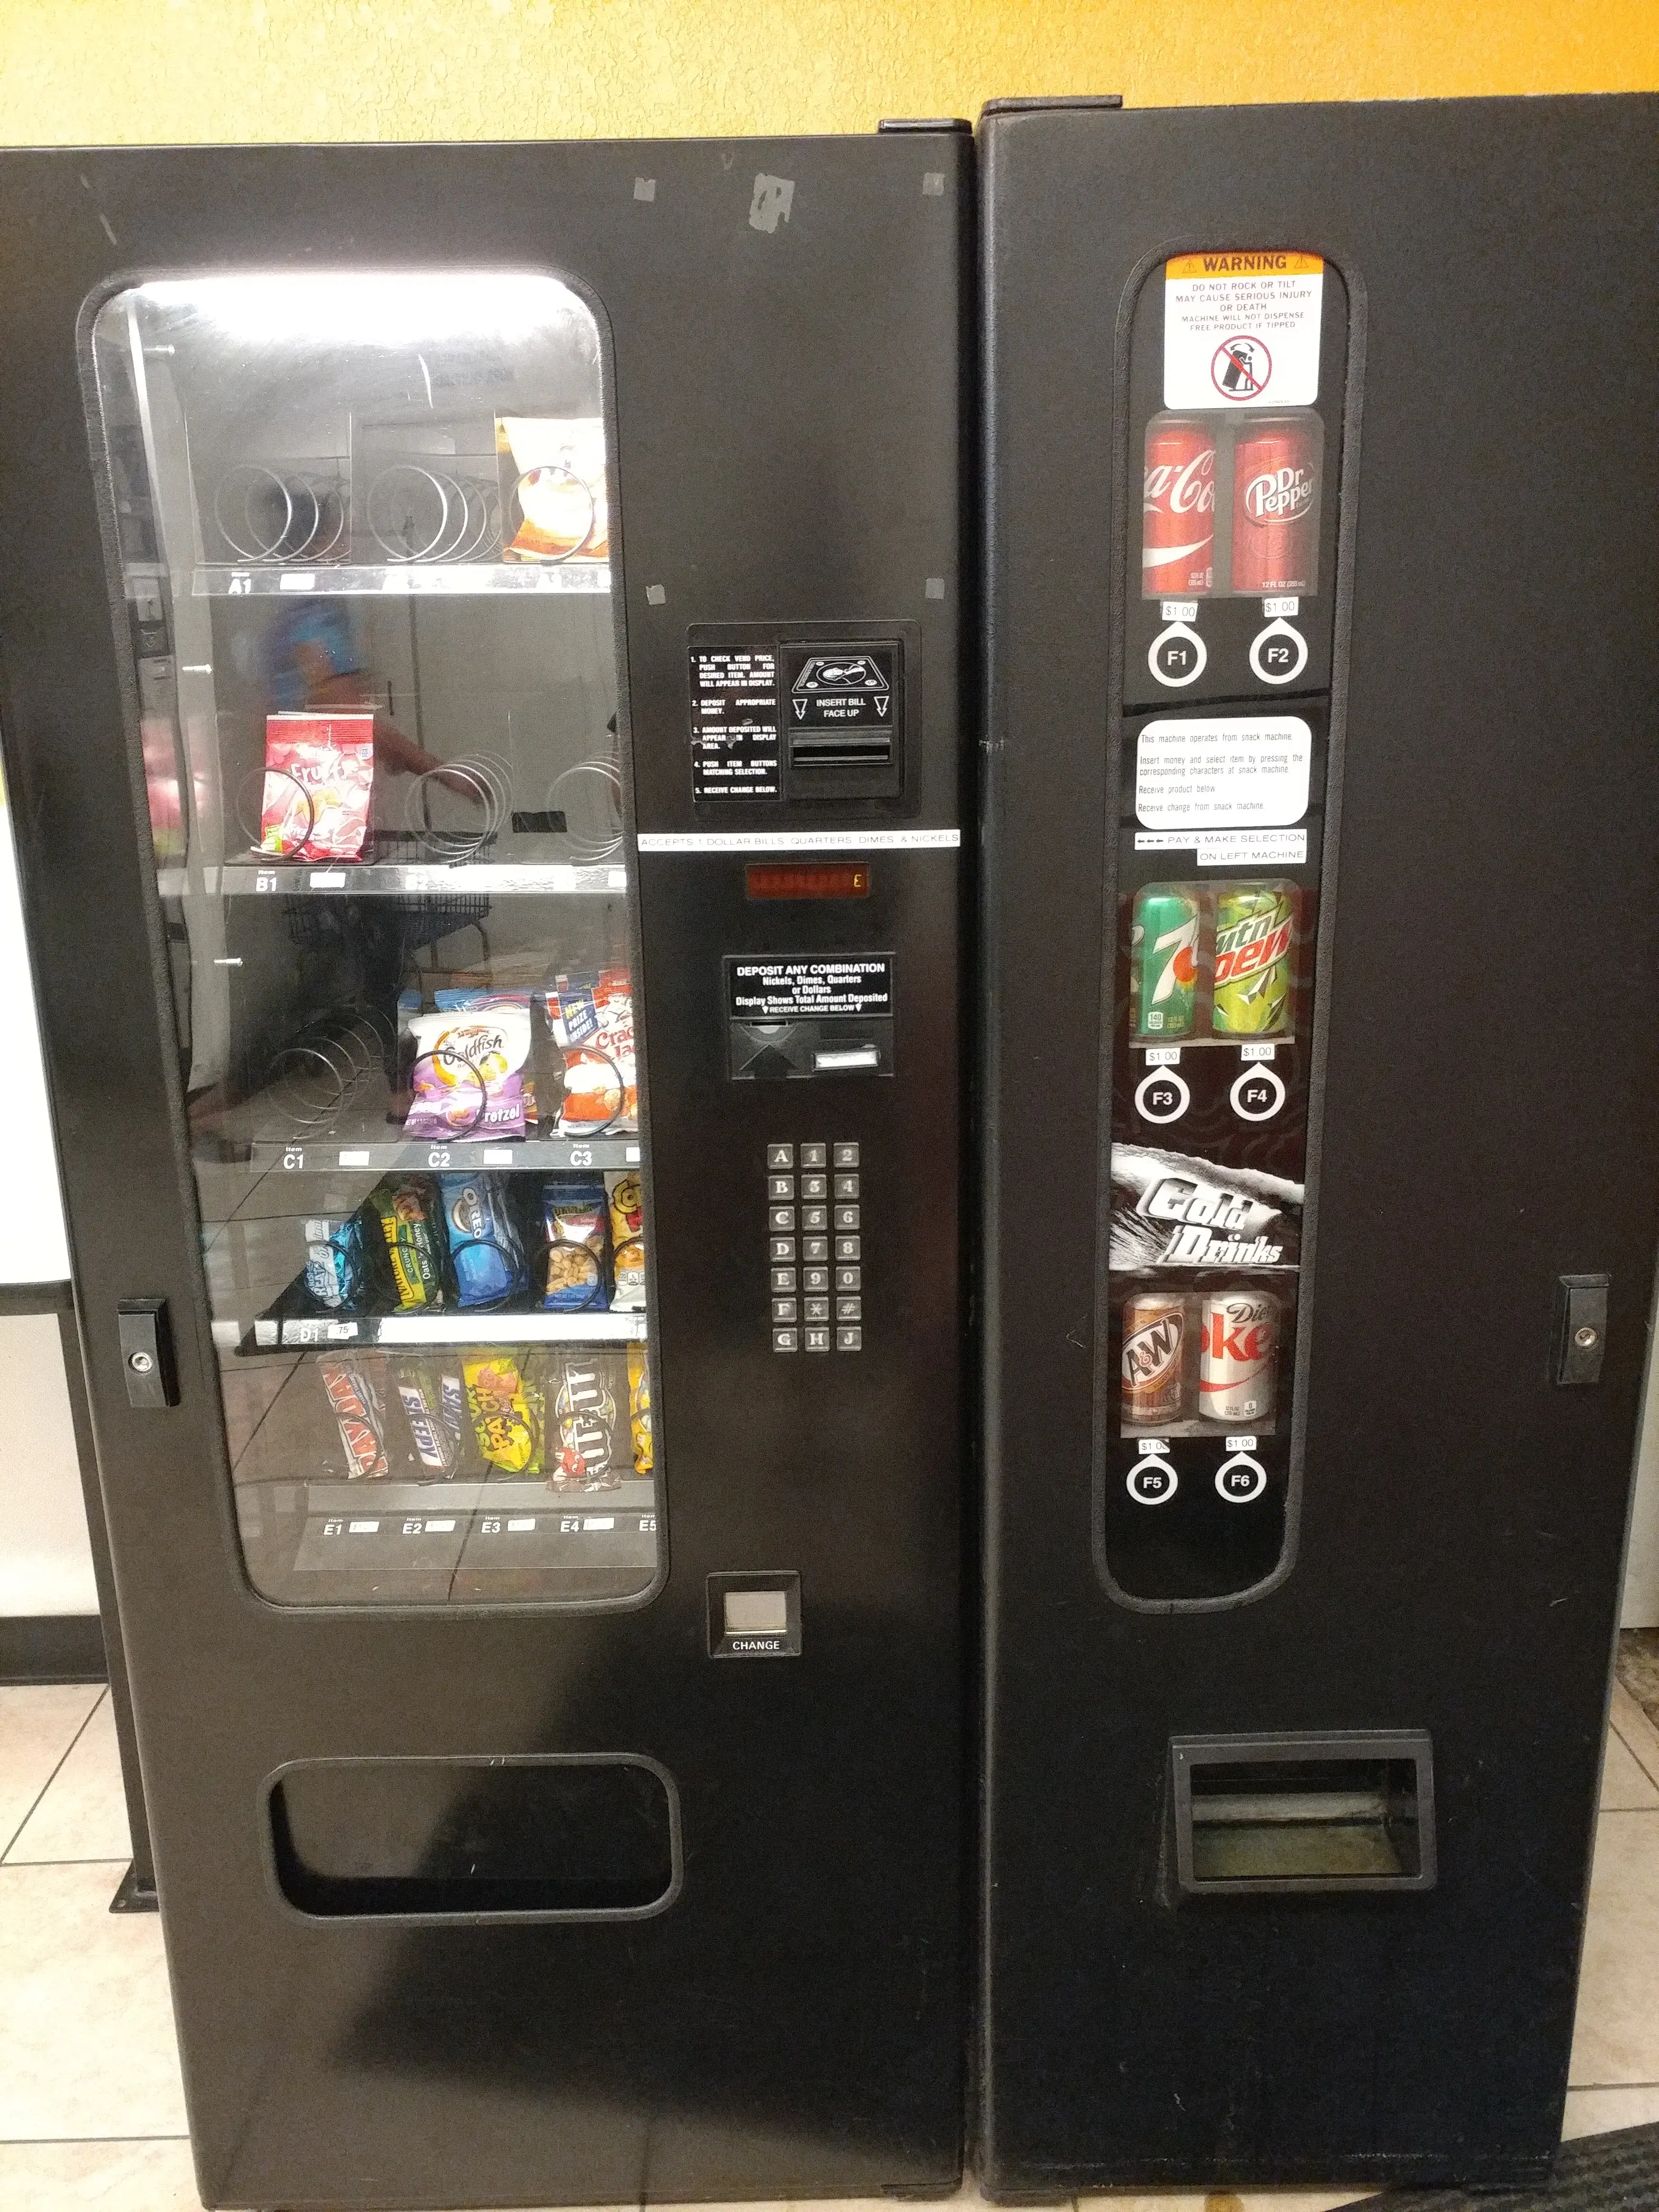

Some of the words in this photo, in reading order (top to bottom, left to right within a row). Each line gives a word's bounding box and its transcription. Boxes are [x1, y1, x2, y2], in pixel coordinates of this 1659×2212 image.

[1203, 255, 1287, 272] WARNING
[1278, 280, 1296, 288] TILT
[1200, 294, 1230, 302] CAUSE
[1235, 292, 1275, 301] SERIOUS
[1279, 290, 1312, 299] INJURY
[1237, 303, 1267, 311] DEATH
[1277, 467, 1304, 494] Dr
[1246, 474, 1313, 517] Pepper
[229, 579, 251, 594] A1
[1167, 650, 1187, 666] F1
[1268, 647, 1289, 663] F2
[816, 698, 847, 706] INSERT
[1141, 734, 1154, 743] This
[1159, 734, 1185, 743] machine
[1190, 734, 1218, 743] operates
[1222, 734, 1237, 742] from
[1241, 733, 1260, 741] snack
[1140, 756, 1159, 764] Insert
[1164, 756, 1185, 765] money
[1190, 755, 1201, 763] and
[1206, 755, 1225, 763] select
[1249, 755, 1256, 763] by
[1260, 754, 1287, 763] pressing
[1140, 767, 1185, 777] corresponding
[1190, 766, 1223, 775] characters
[1139, 786, 1164, 794] Receive
[1168, 785, 1192, 795] product
[1138, 803, 1163, 812] Receive
[1167, 803, 1190, 812] change
[791, 836, 852, 845] QUARTERS
[859, 836, 894, 844] DIMES
[911, 834, 958, 842] NICKELS
[1241, 834, 1305, 842] SELECTION
[1252, 851, 1304, 859] MACHINE
[256, 877, 277, 892] B1
[854, 874, 861, 887] E
[737, 966, 783, 976] DEPOSIT
[785, 965, 808, 974] ANY
[810, 963, 885, 974] COMBINATION
[827, 975, 862, 984] Quarters
[802, 985, 831, 994] Dollars
[736, 997, 766, 1007] Display
[767, 996, 793, 1005] Shows
[795, 995, 815, 1004] Total
[816, 994, 847, 1003] Amount
[848, 993, 888, 1003] Deposited
[568, 1009, 588, 1031] PRIZE
[1152, 1092, 1173, 1105] F3
[1247, 1089, 1268, 1103] F4
[284, 1154, 304, 1169] C1
[429, 1152, 450, 1167] C2
[570, 1151, 592, 1166] C3
[774, 1149, 789, 1163] A
[810, 1149, 818, 1162] 1
[842, 1149, 853, 1161] 2
[776, 1181, 788, 1194] B
[809, 1180, 820, 1193] 3
[843, 1180, 853, 1193] 4
[1145, 1178, 1253, 1230] Cold
[463, 1188, 482, 1239] OREO
[775, 1211, 789, 1225] C
[810, 1211, 820, 1224] 5
[843, 1211, 853, 1223] 6
[776, 1242, 790, 1255] D
[810, 1242, 821, 1254] 7
[843, 1242, 854, 1254] 8
[1162, 1225, 1283, 1264] Drinks
[777, 1273, 790, 1286] E
[810, 1272, 821, 1285] 9
[843, 1272, 853, 1284] 0
[300, 1328, 318, 1342] D1
[778, 1333, 791, 1346] G
[810, 1332, 824, 1345] H
[843, 1332, 854, 1344] J
[1126, 1318, 1174, 1387] A&W
[1143, 1477, 1162, 1489] F5
[1231, 1475, 1250, 1487] F6
[324, 1525, 342, 1535] E1
[402, 1523, 422, 1534] E2
[481, 1522, 501, 1533] E3
[560, 1521, 579, 1532] E4
[639, 1520, 656, 1531] E5
[733, 1641, 780, 1650] CHANGE
